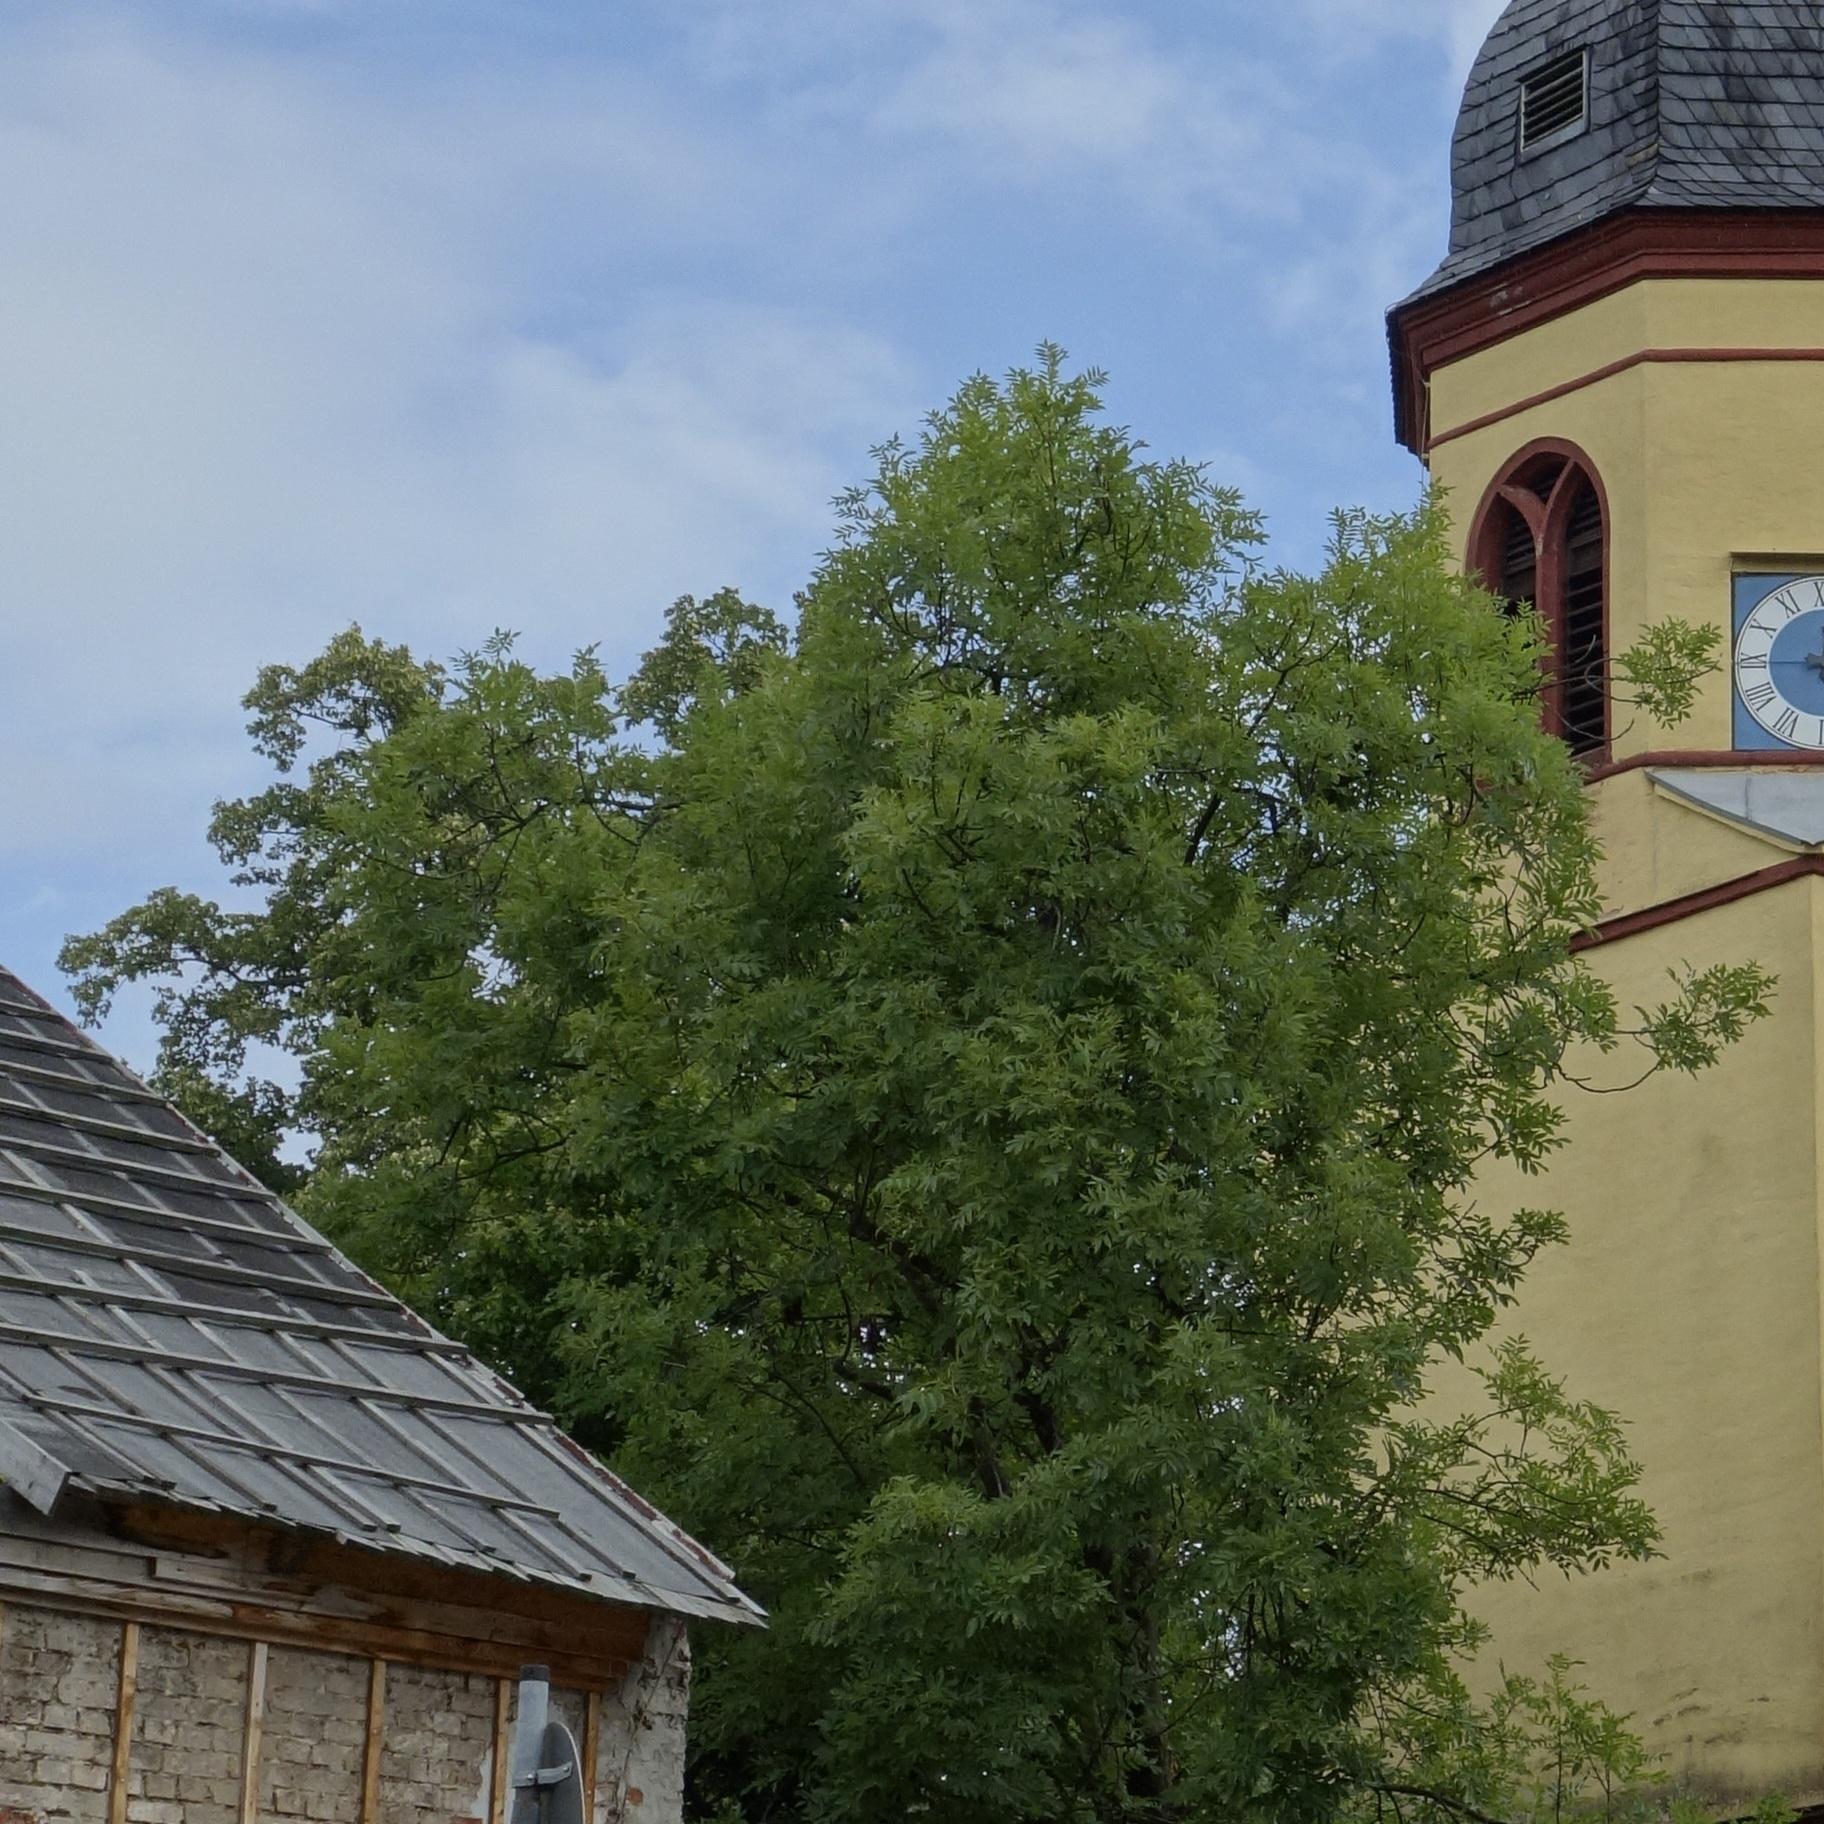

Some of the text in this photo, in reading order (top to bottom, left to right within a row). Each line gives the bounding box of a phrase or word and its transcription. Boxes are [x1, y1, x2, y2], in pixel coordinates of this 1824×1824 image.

[1775, 590, 1801, 618] XI
[1749, 619, 1777, 639] X
[1740, 652, 1767, 669] IX
[1744, 681, 1777, 712] VIII
[1772, 707, 1799, 738] VII
